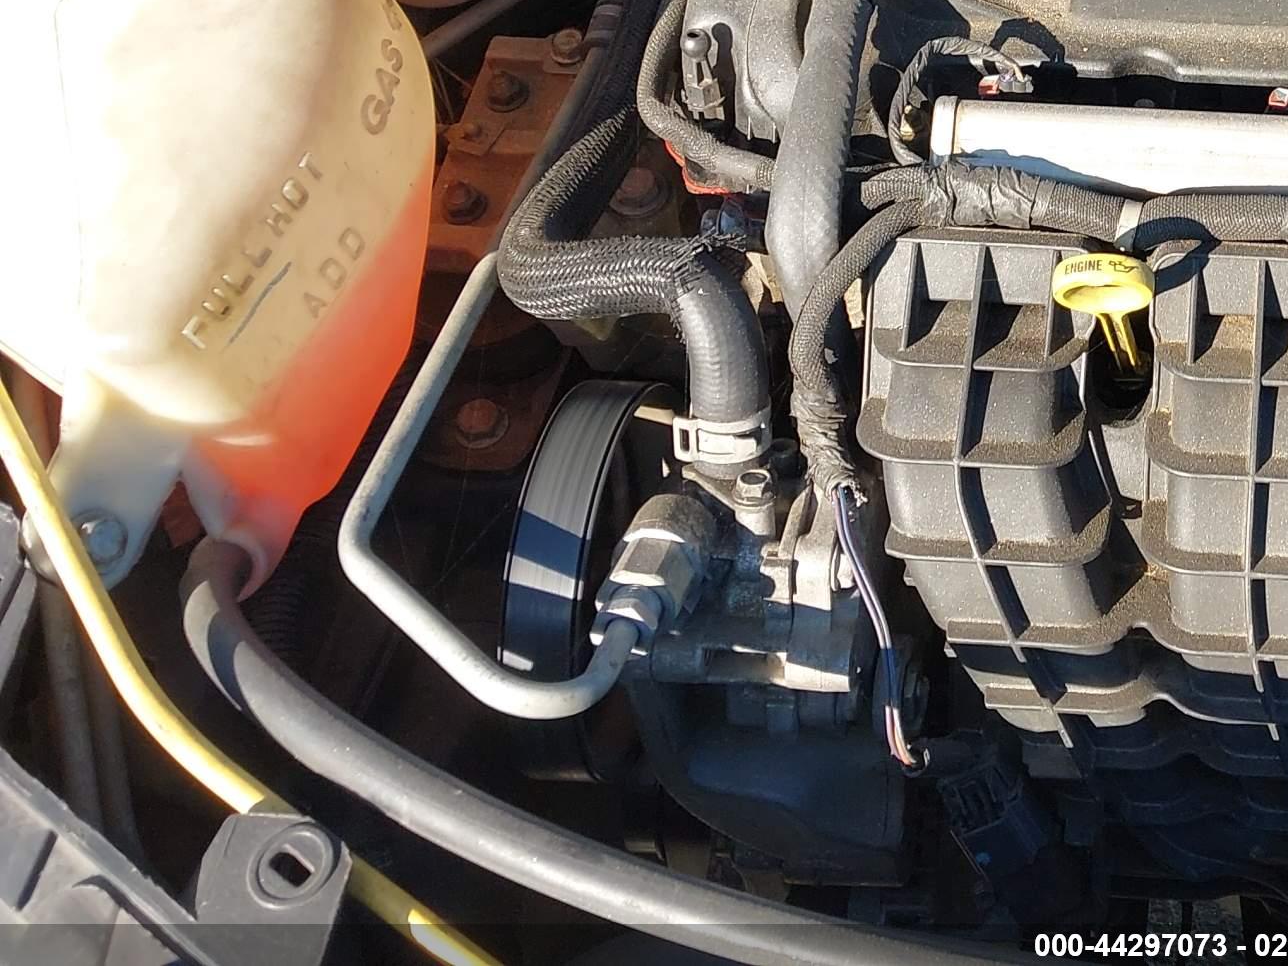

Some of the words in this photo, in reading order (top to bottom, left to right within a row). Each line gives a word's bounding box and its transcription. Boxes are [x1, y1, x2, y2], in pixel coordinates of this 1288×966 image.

[361, 38, 403, 135] GAS
[181, 246, 273, 350] FULL
[264, 151, 323, 237] HOT
[303, 227, 365, 318] ADD
[1064, 259, 1103, 275] ENGINE
